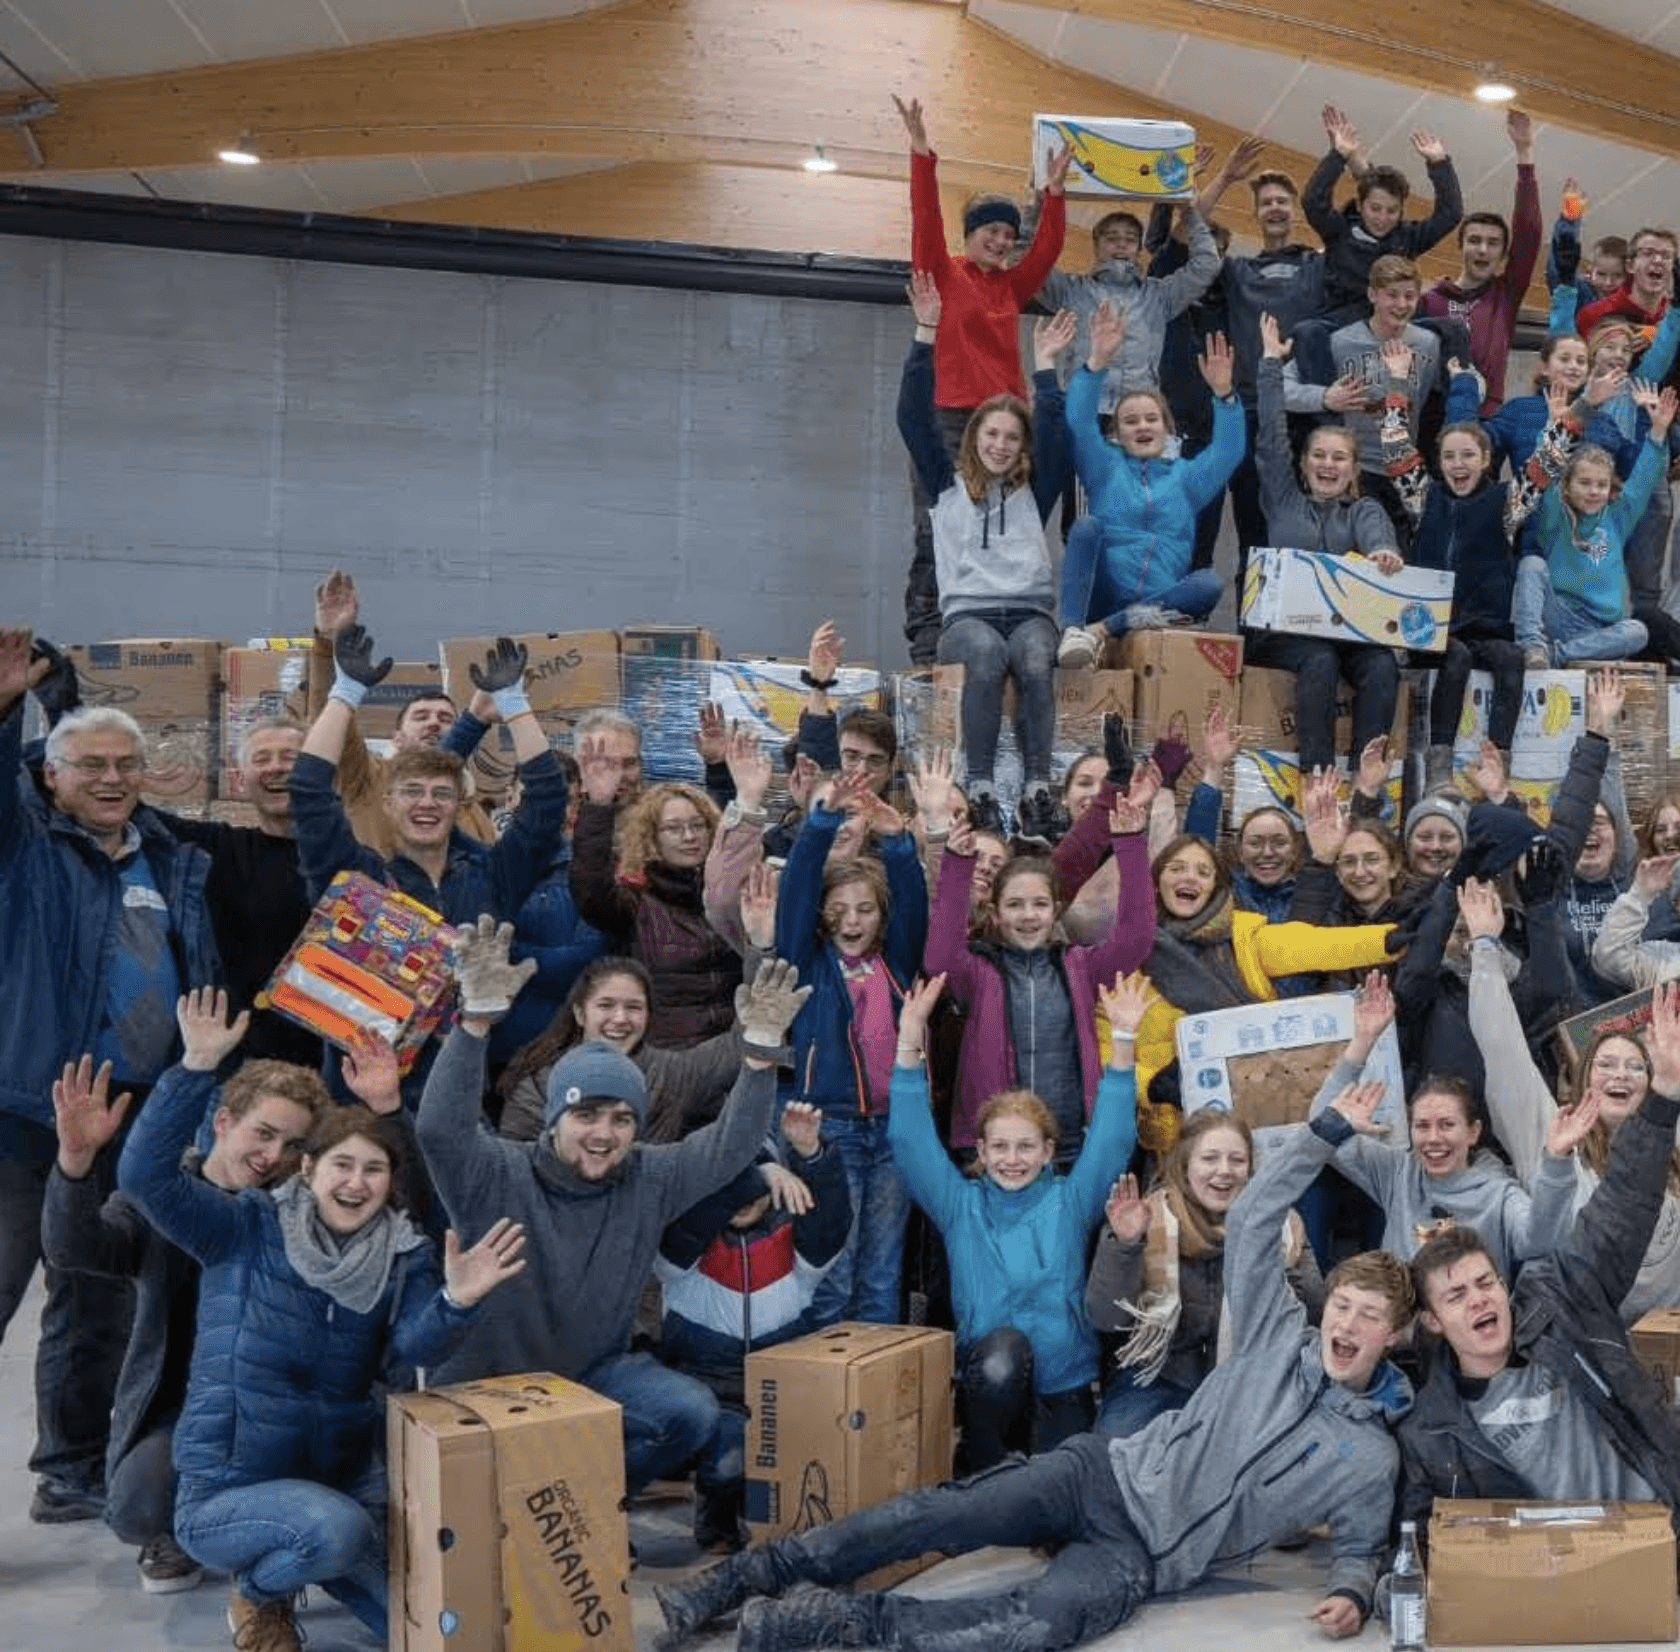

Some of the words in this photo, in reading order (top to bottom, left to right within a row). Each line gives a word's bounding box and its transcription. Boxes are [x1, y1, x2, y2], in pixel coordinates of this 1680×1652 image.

[756, 1379, 777, 1468] Bananen
[553, 1479, 591, 1544] ORGANIC
[526, 1486, 612, 1638] BANANAS
